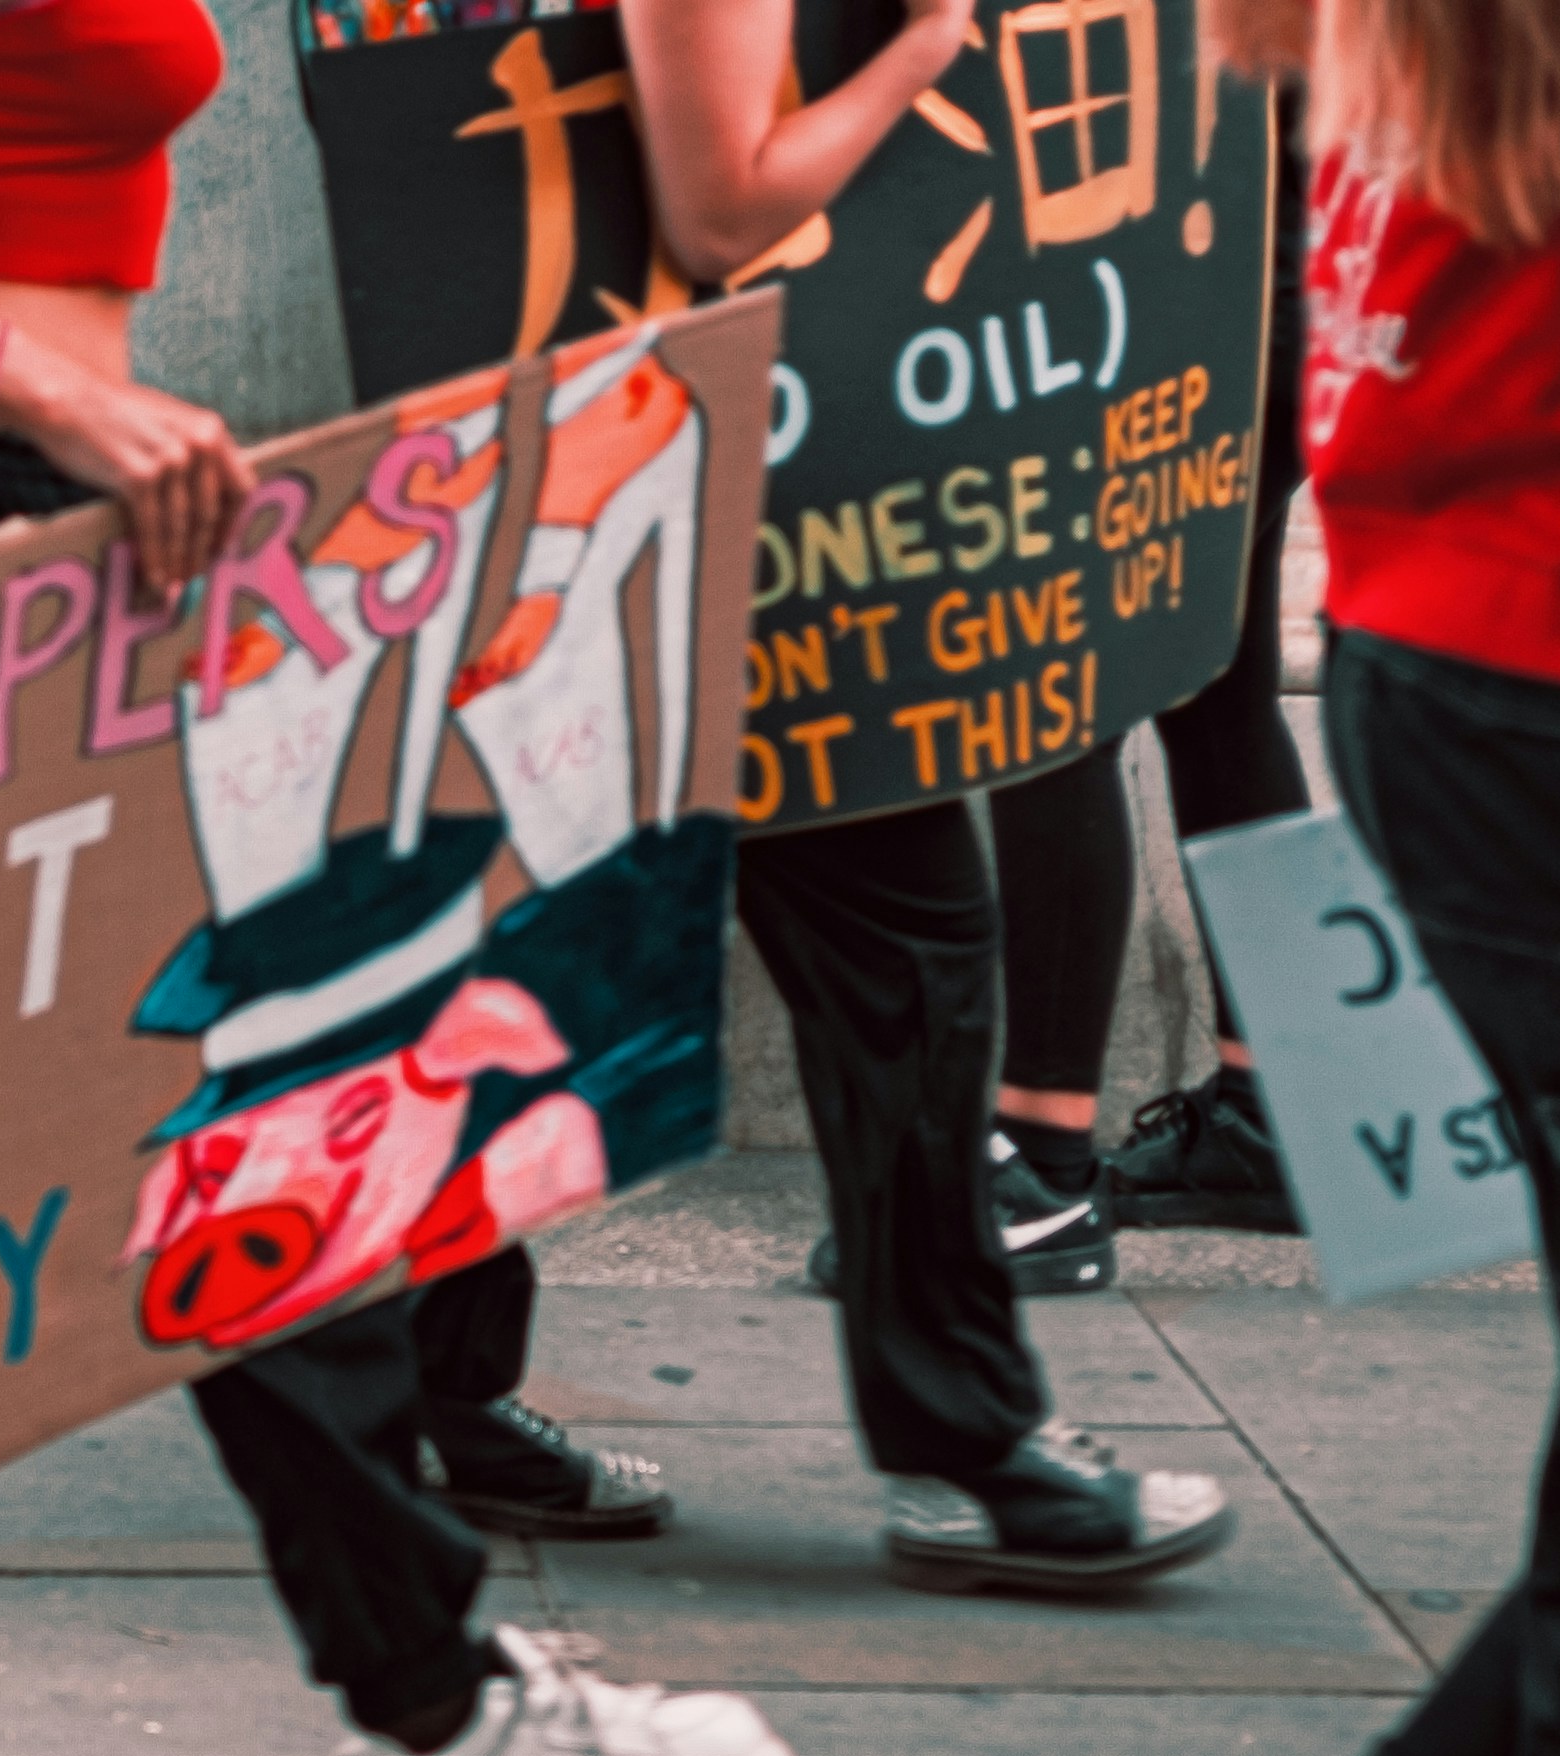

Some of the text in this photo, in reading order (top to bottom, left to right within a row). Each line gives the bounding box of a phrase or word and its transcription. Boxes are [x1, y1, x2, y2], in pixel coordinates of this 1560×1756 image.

[895, 258, 1127, 426] OIL)
[1103, 365, 1209, 471] KEEP
[1096, 430, 1254, 551] GOING!
[927, 570, 1084, 673] GIVE
[1113, 535, 1183, 619] UP!
[891, 650, 1097, 788] THIS!
[1354, 1113, 1415, 1200] A
